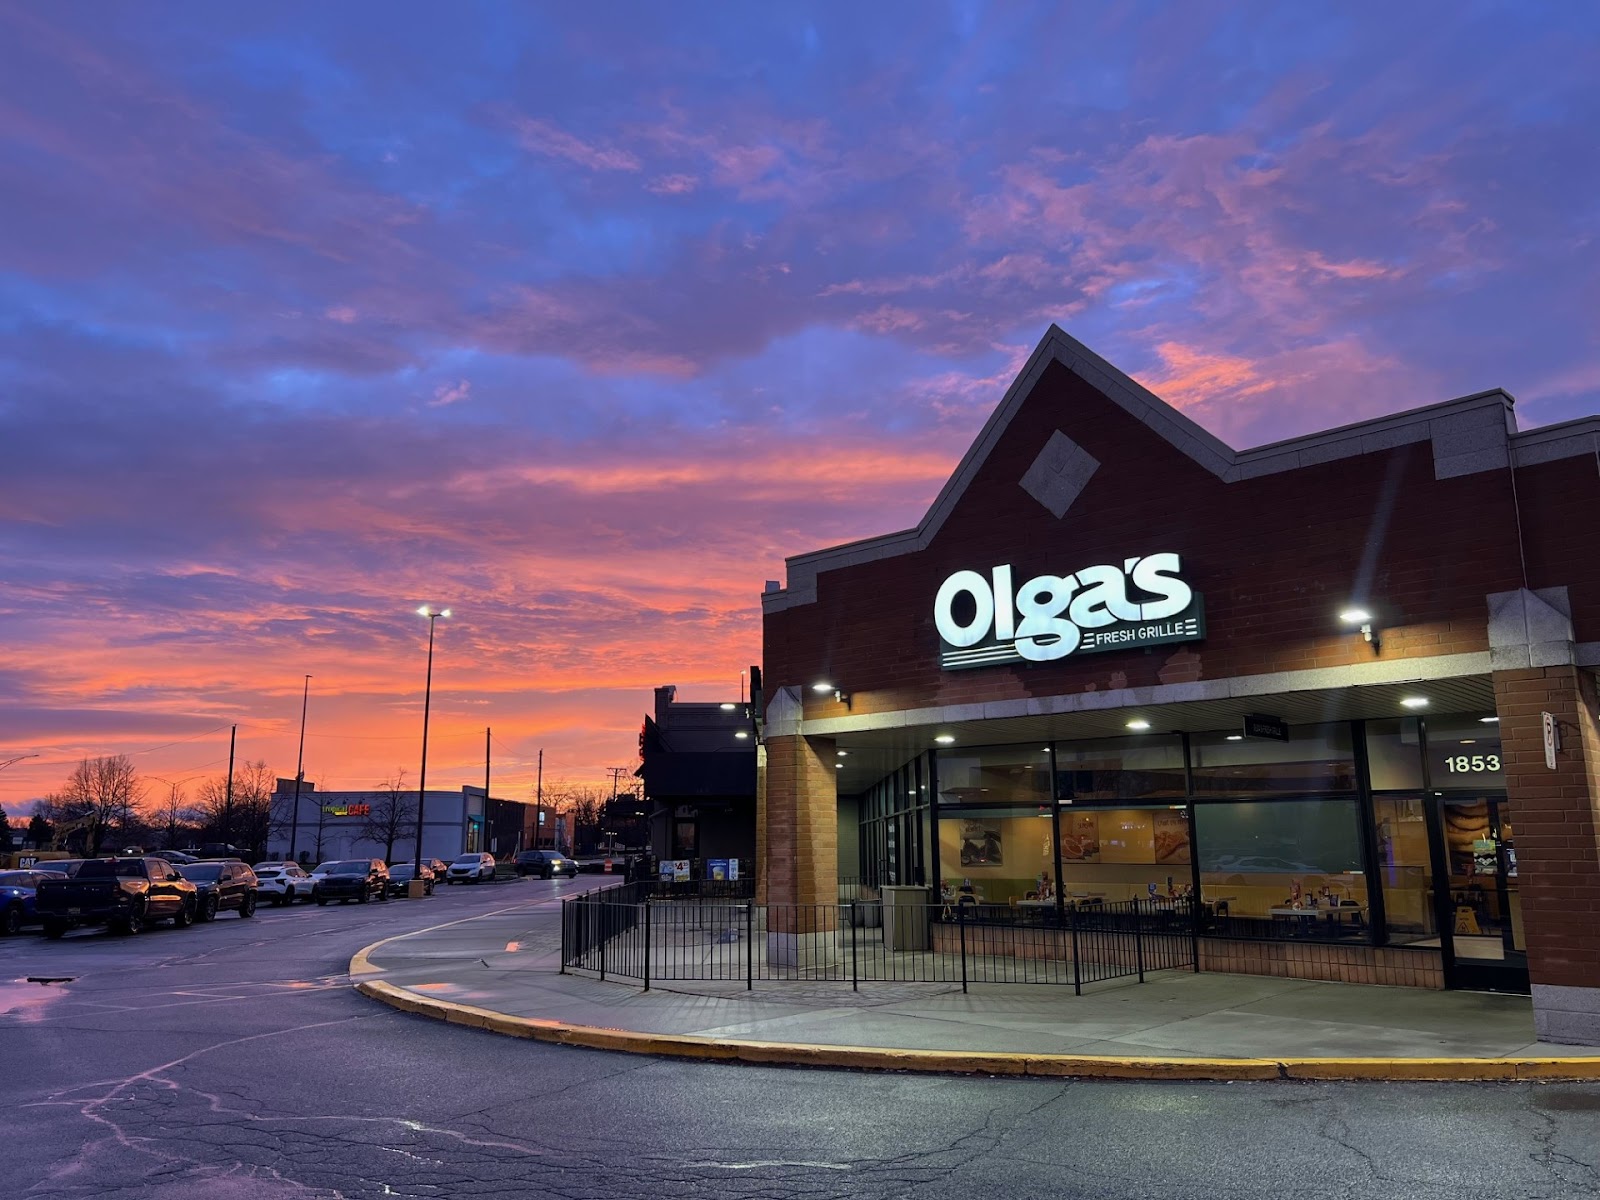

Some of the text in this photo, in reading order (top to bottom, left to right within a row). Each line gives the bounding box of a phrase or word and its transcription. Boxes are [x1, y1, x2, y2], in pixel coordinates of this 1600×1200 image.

[934, 552, 1192, 661] Olga's
[1096, 622, 1184, 645] FRESH GRILLE
[1445, 755, 1501, 772] 1853
[20, 857, 36, 868] CAT
